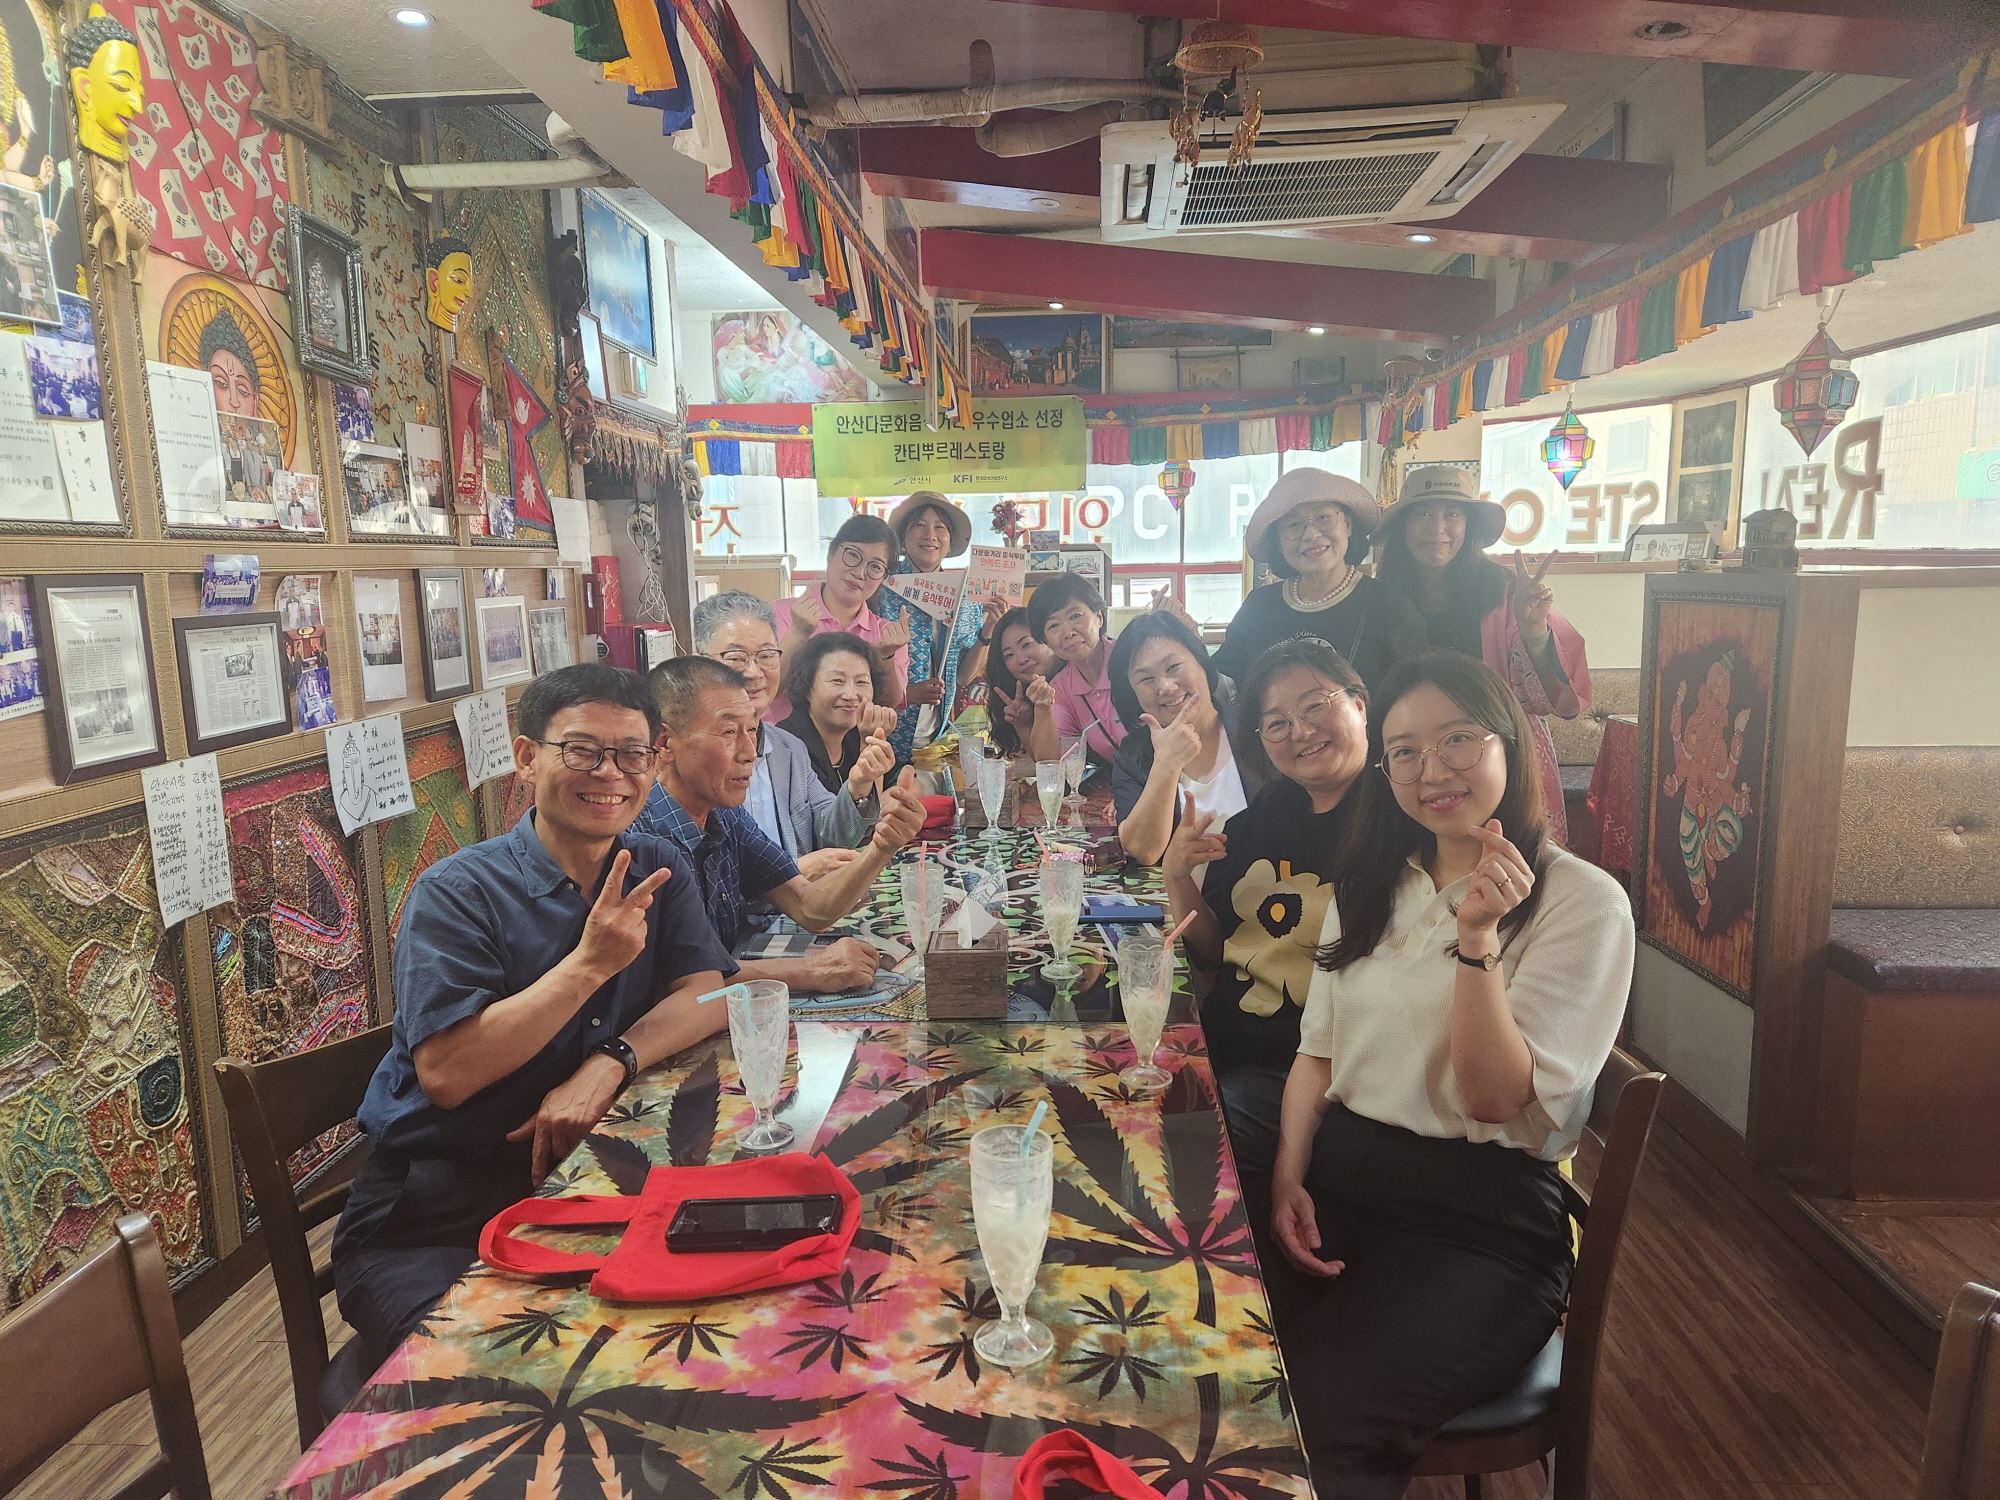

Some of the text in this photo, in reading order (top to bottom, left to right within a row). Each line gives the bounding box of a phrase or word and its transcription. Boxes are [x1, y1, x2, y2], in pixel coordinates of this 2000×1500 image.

[836, 408, 1063, 435] 안산다문화음거 우수업소 선정
[893, 441, 1006, 462] 칸티뿌르레스토랑
[909, 475, 931, 485] 안산시
[953, 474, 973, 484] KFI
[1230, 483, 1269, 539] P
[972, 548, 1026, 560] 다문화거리 미식투어
[980, 558, 1017, 570] 만족도 조사
[922, 592, 955, 609] 음식투어!
